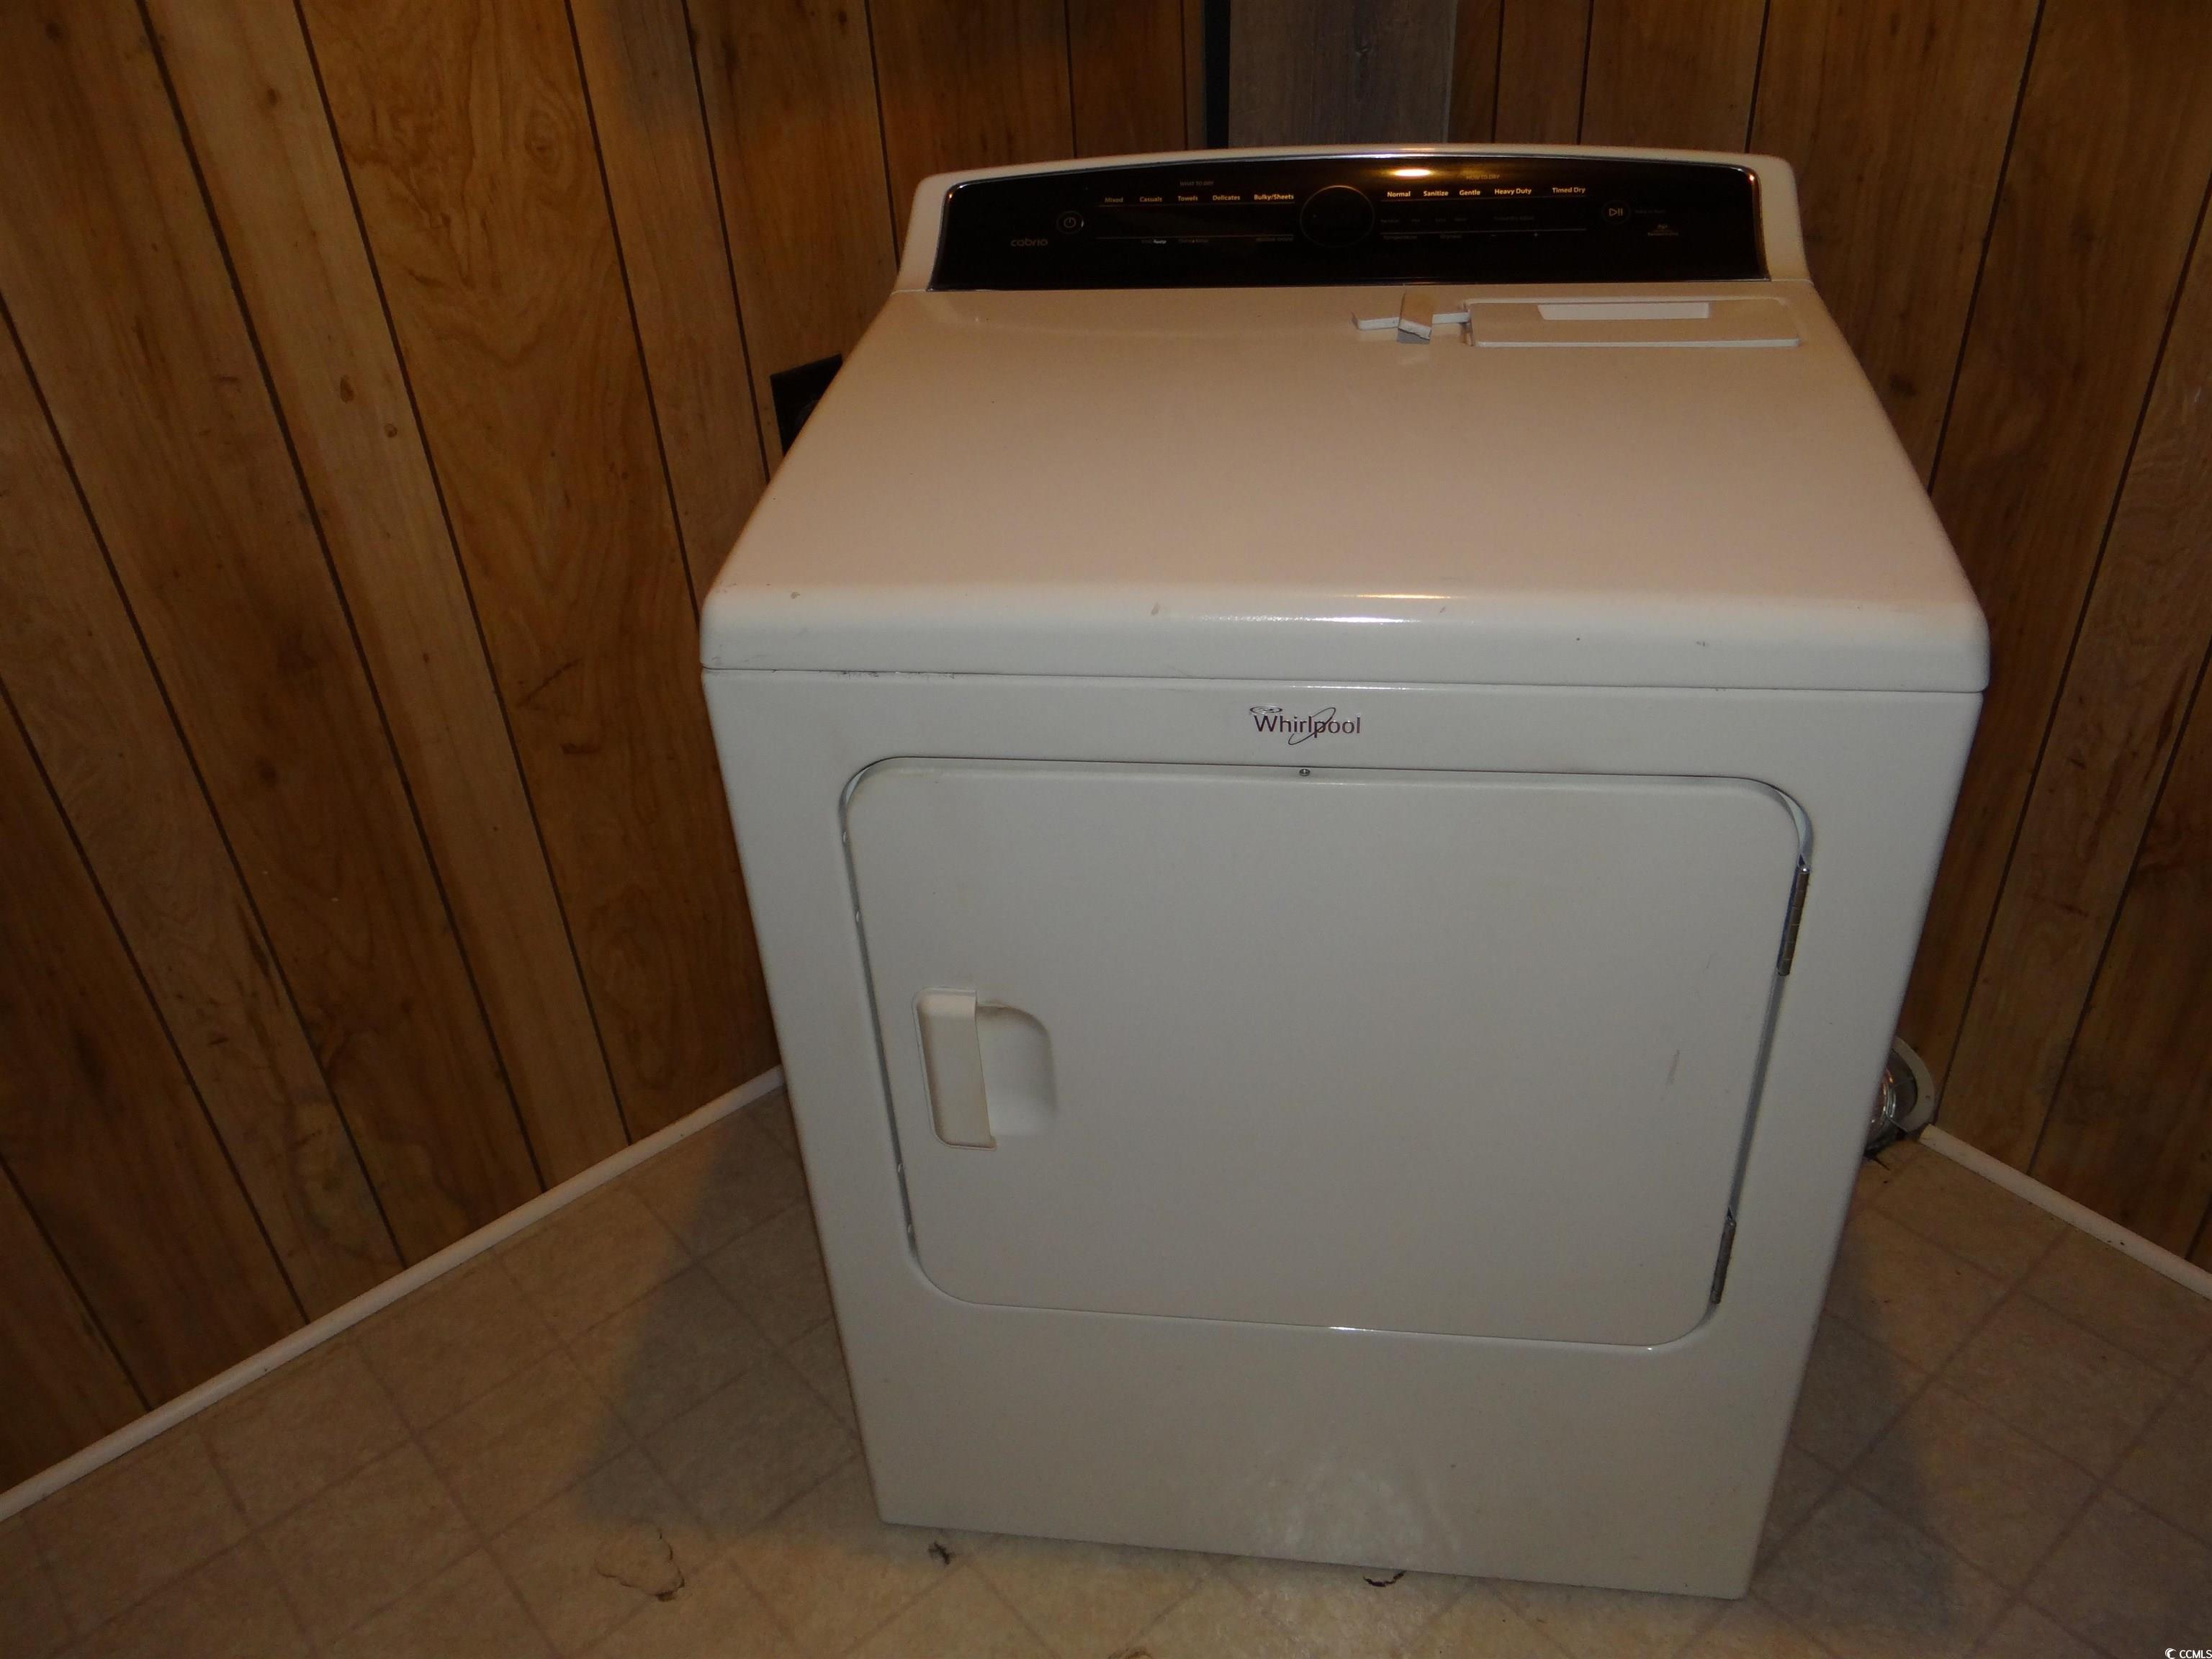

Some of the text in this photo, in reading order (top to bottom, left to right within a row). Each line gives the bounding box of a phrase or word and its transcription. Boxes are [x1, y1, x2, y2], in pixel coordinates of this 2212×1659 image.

[1494, 187, 1532, 197] Heavy Duty
[1573, 186, 1586, 194] Dry
[1254, 193, 1295, 202] Bulky/Sheets
[1010, 237, 1048, 247] cabrio
[1254, 715, 1360, 739] Whirlpool
